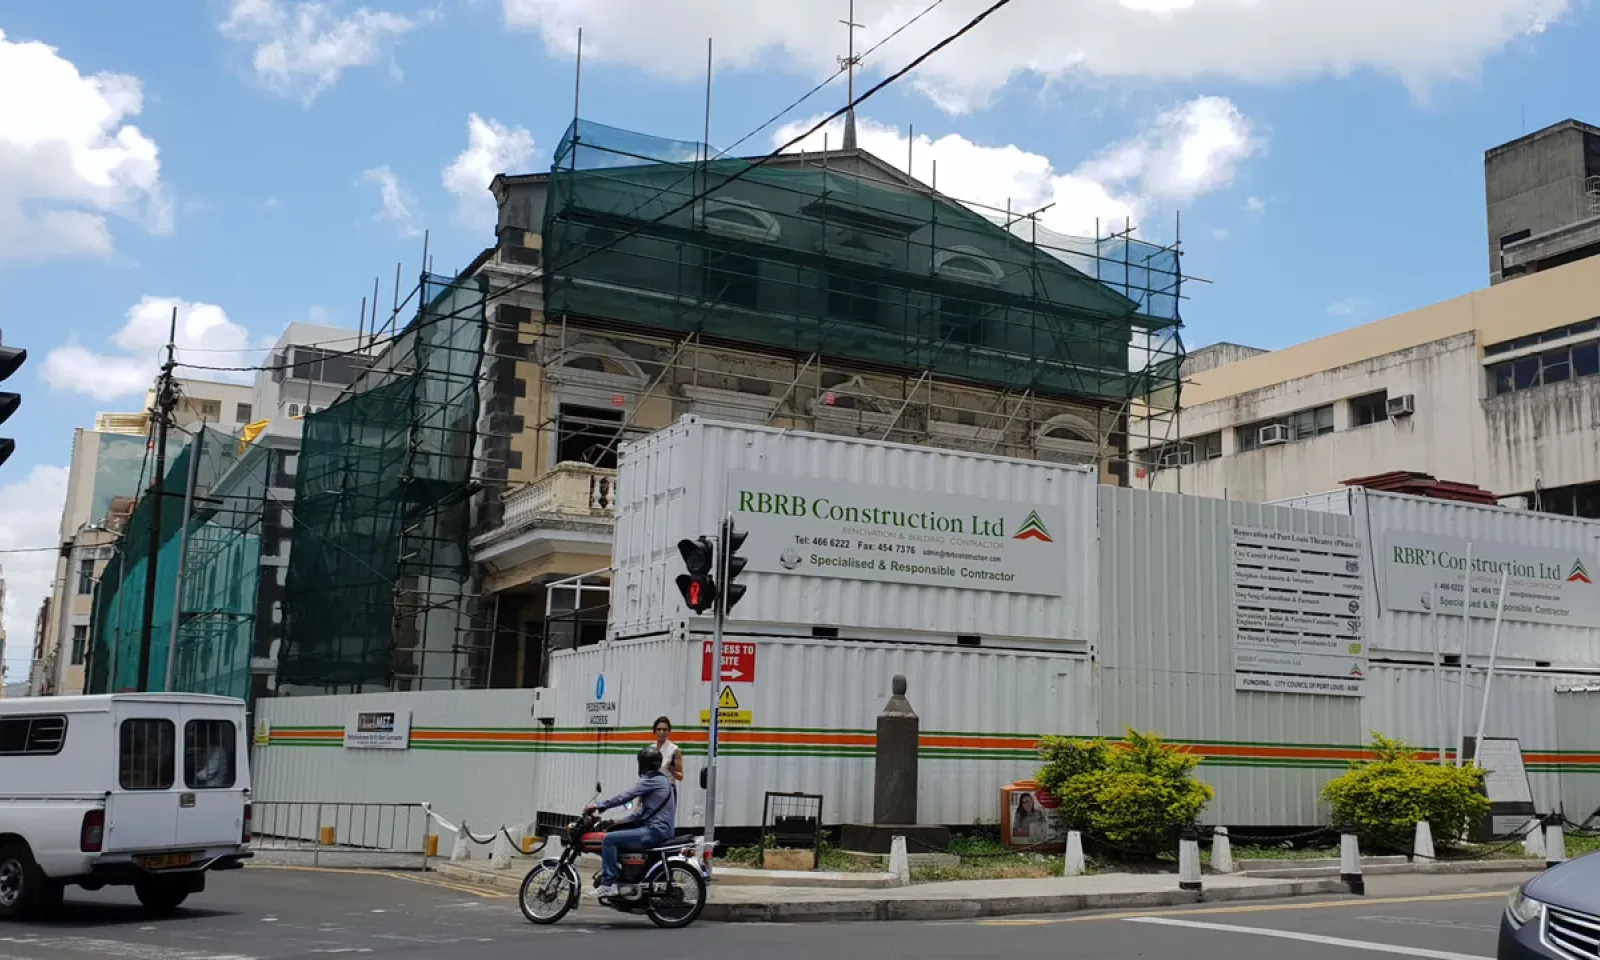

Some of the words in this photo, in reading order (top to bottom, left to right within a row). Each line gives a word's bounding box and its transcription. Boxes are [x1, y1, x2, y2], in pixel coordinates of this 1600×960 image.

[738, 490, 806, 517] RBRB
[812, 498, 964, 533] Construction
[971, 515, 1005, 537] Ltd
[842, 526, 896, 540] RENOVATION
[908, 534, 945, 544] BUILDING
[949, 538, 1004, 549] CONTRACTOR
[1233, 528, 1268, 539] Renovation
[795, 535, 810, 545] Tel:
[812, 537, 828, 546] 466
[829, 538, 850, 549] 6222
[857, 540, 876, 550] Fax:
[878, 542, 893, 552] 454
[896, 544, 916, 554] 7376
[810, 554, 874, 569] Specialised
[877, 560, 886, 570] &
[890, 561, 955, 577] Responsible
[960, 567, 1015, 581] Contractor
[1540, 563, 1561, 581] Ltd
[704, 644, 740, 654] AESS
[742, 645, 754, 656] TO
[720, 656, 740, 666] SITE
[586, 701, 616, 712] PEDESTRIAN
[590, 715, 608, 725] ACCESS
